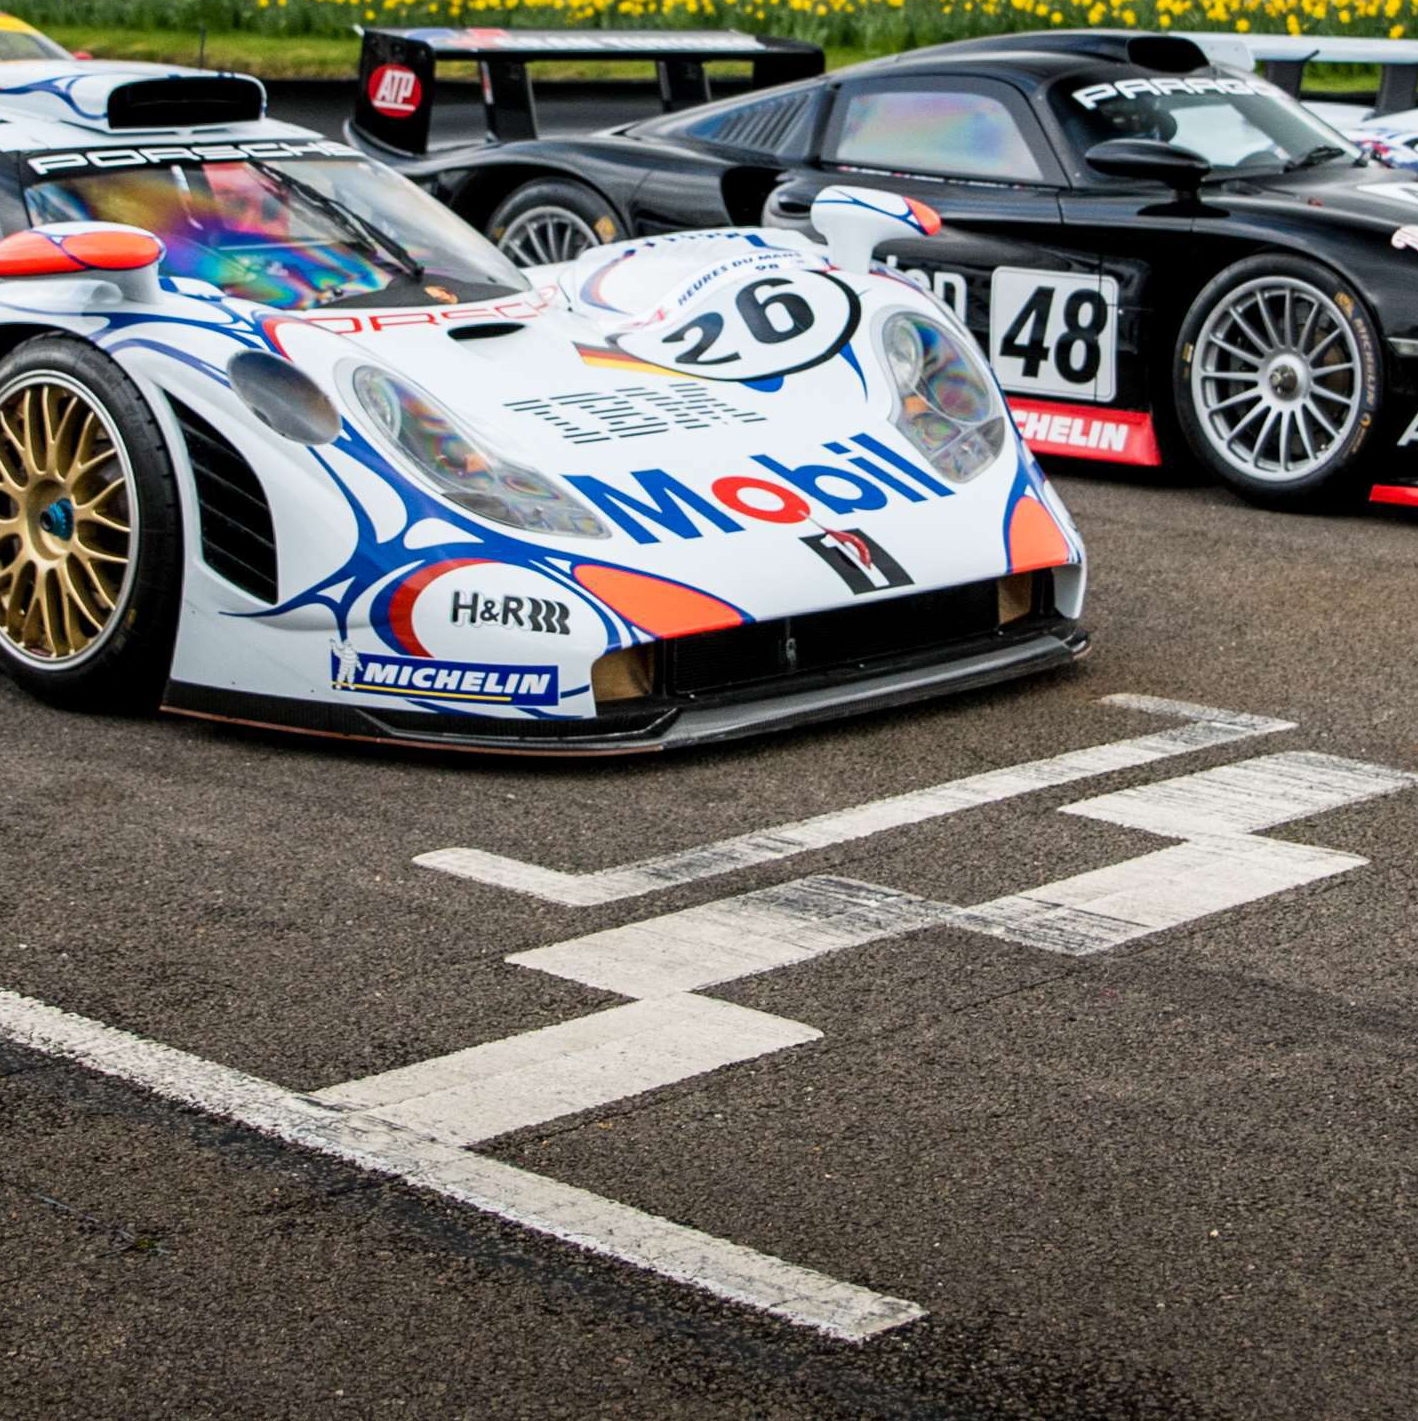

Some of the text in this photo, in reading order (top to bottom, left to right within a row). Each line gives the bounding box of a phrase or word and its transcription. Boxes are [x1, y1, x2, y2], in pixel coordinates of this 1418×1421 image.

[374, 68, 415, 101] ATP
[27, 141, 368, 175] PORSCHE
[677, 264, 728, 306] HEURES
[731, 257, 754, 269] DU
[661, 277, 816, 366] 26
[999, 285, 1108, 385] 48
[501, 383, 769, 445] IBM
[1013, 411, 1130, 453] CHELIN
[560, 432, 957, 545] Mobil
[450, 590, 525, 627] H&R
[362, 661, 552, 695] MICHELIN
